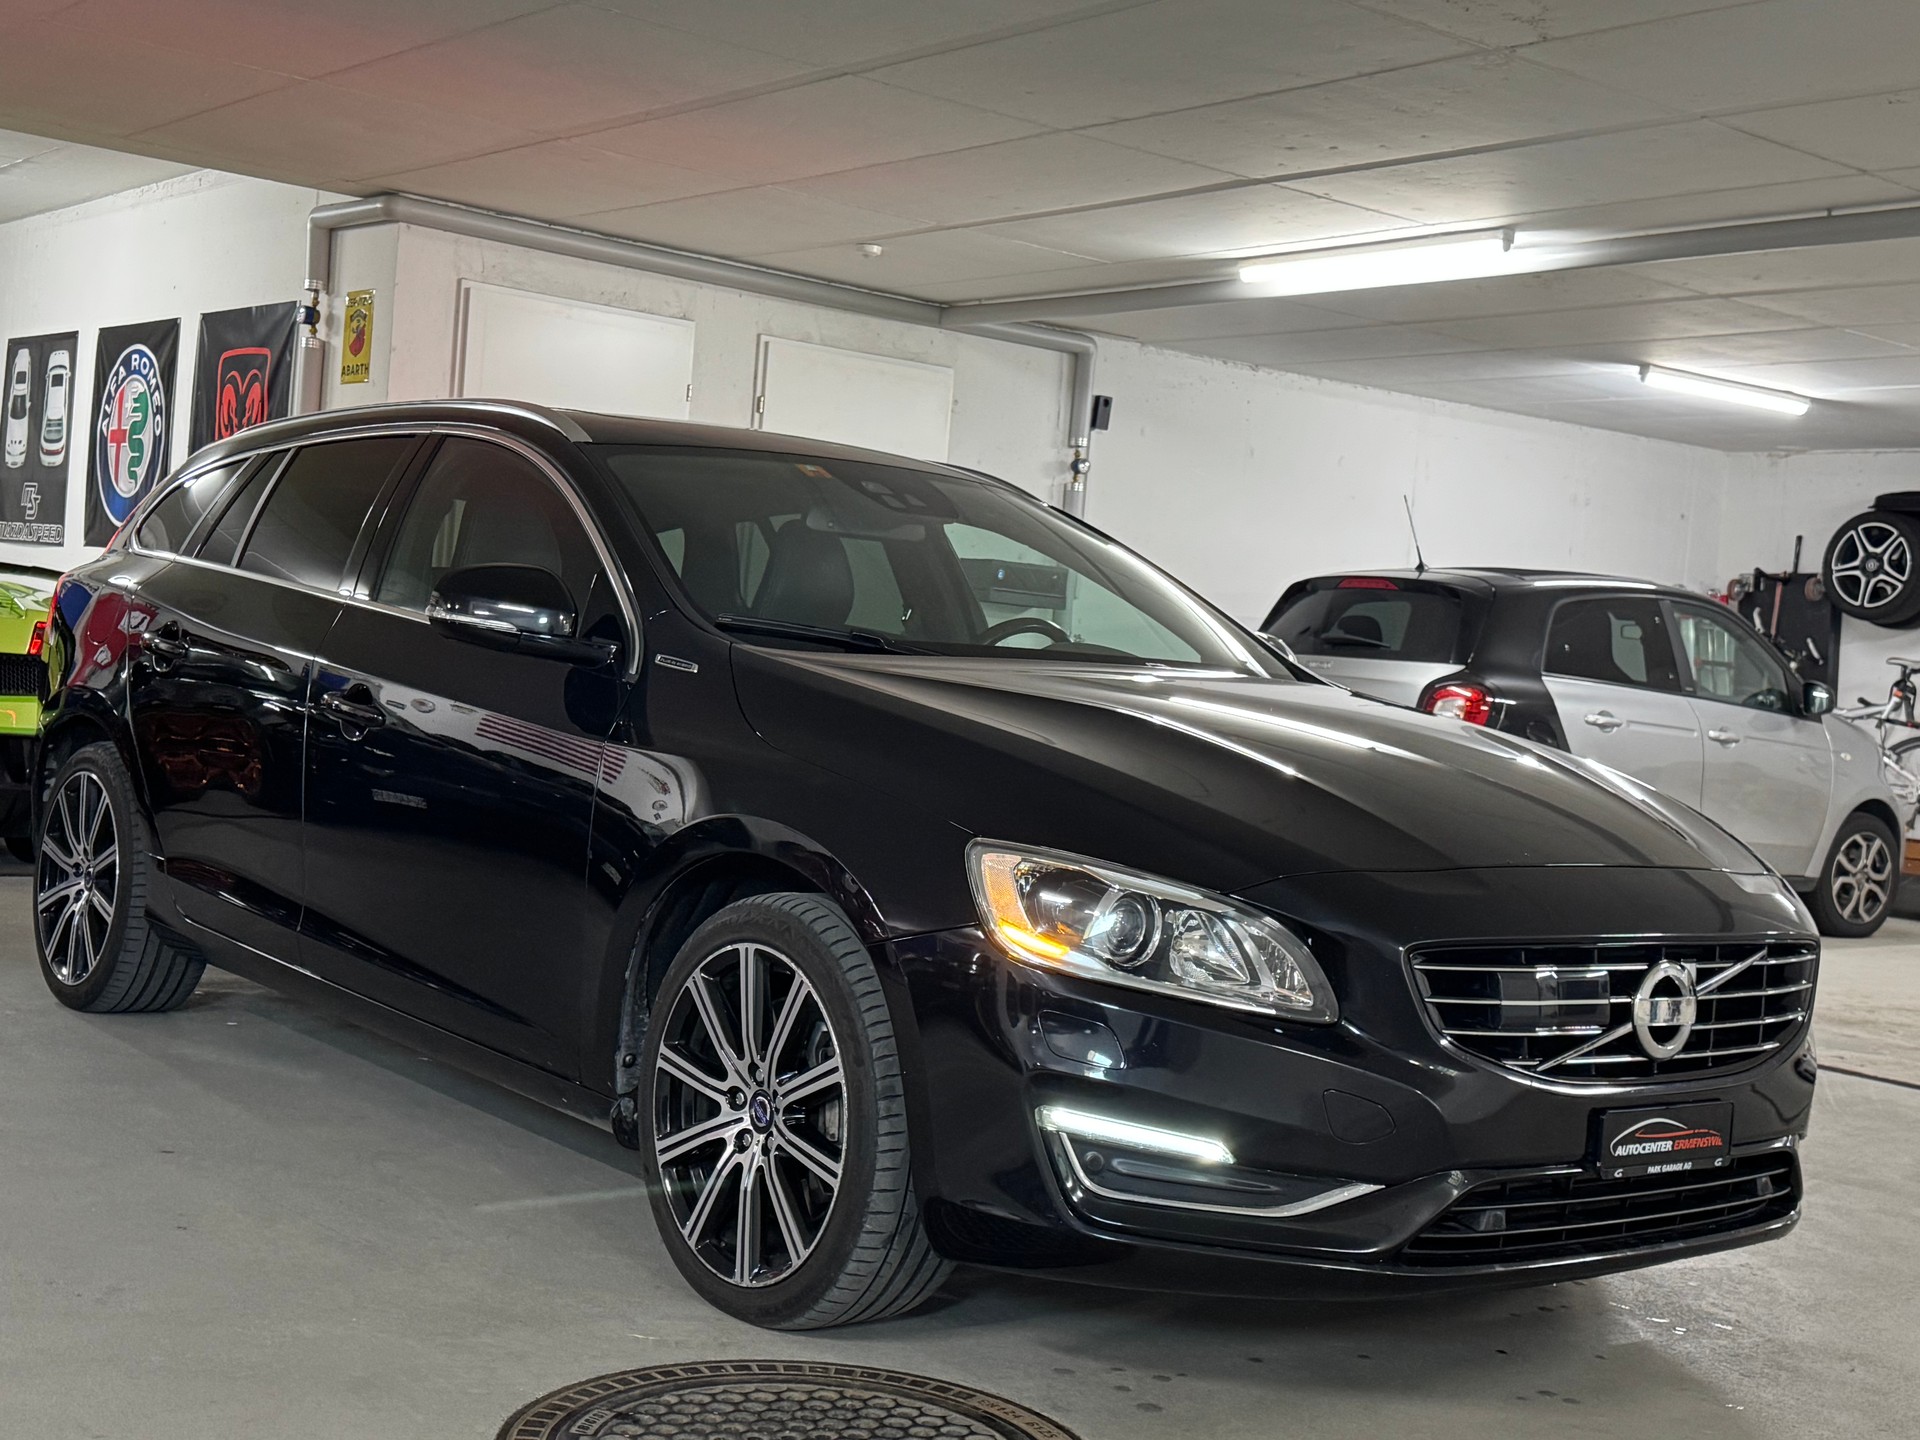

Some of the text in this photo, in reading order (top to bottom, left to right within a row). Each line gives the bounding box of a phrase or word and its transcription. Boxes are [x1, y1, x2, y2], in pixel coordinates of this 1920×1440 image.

[341, 363, 369, 377] ABARTH
[102, 353, 162, 437] ALFA ROMEO
[1615, 1141, 1673, 1156] AUTOCENTER
[1647, 1165, 1661, 1174] PARK
[1661, 1163, 1683, 1173] GARAGE
